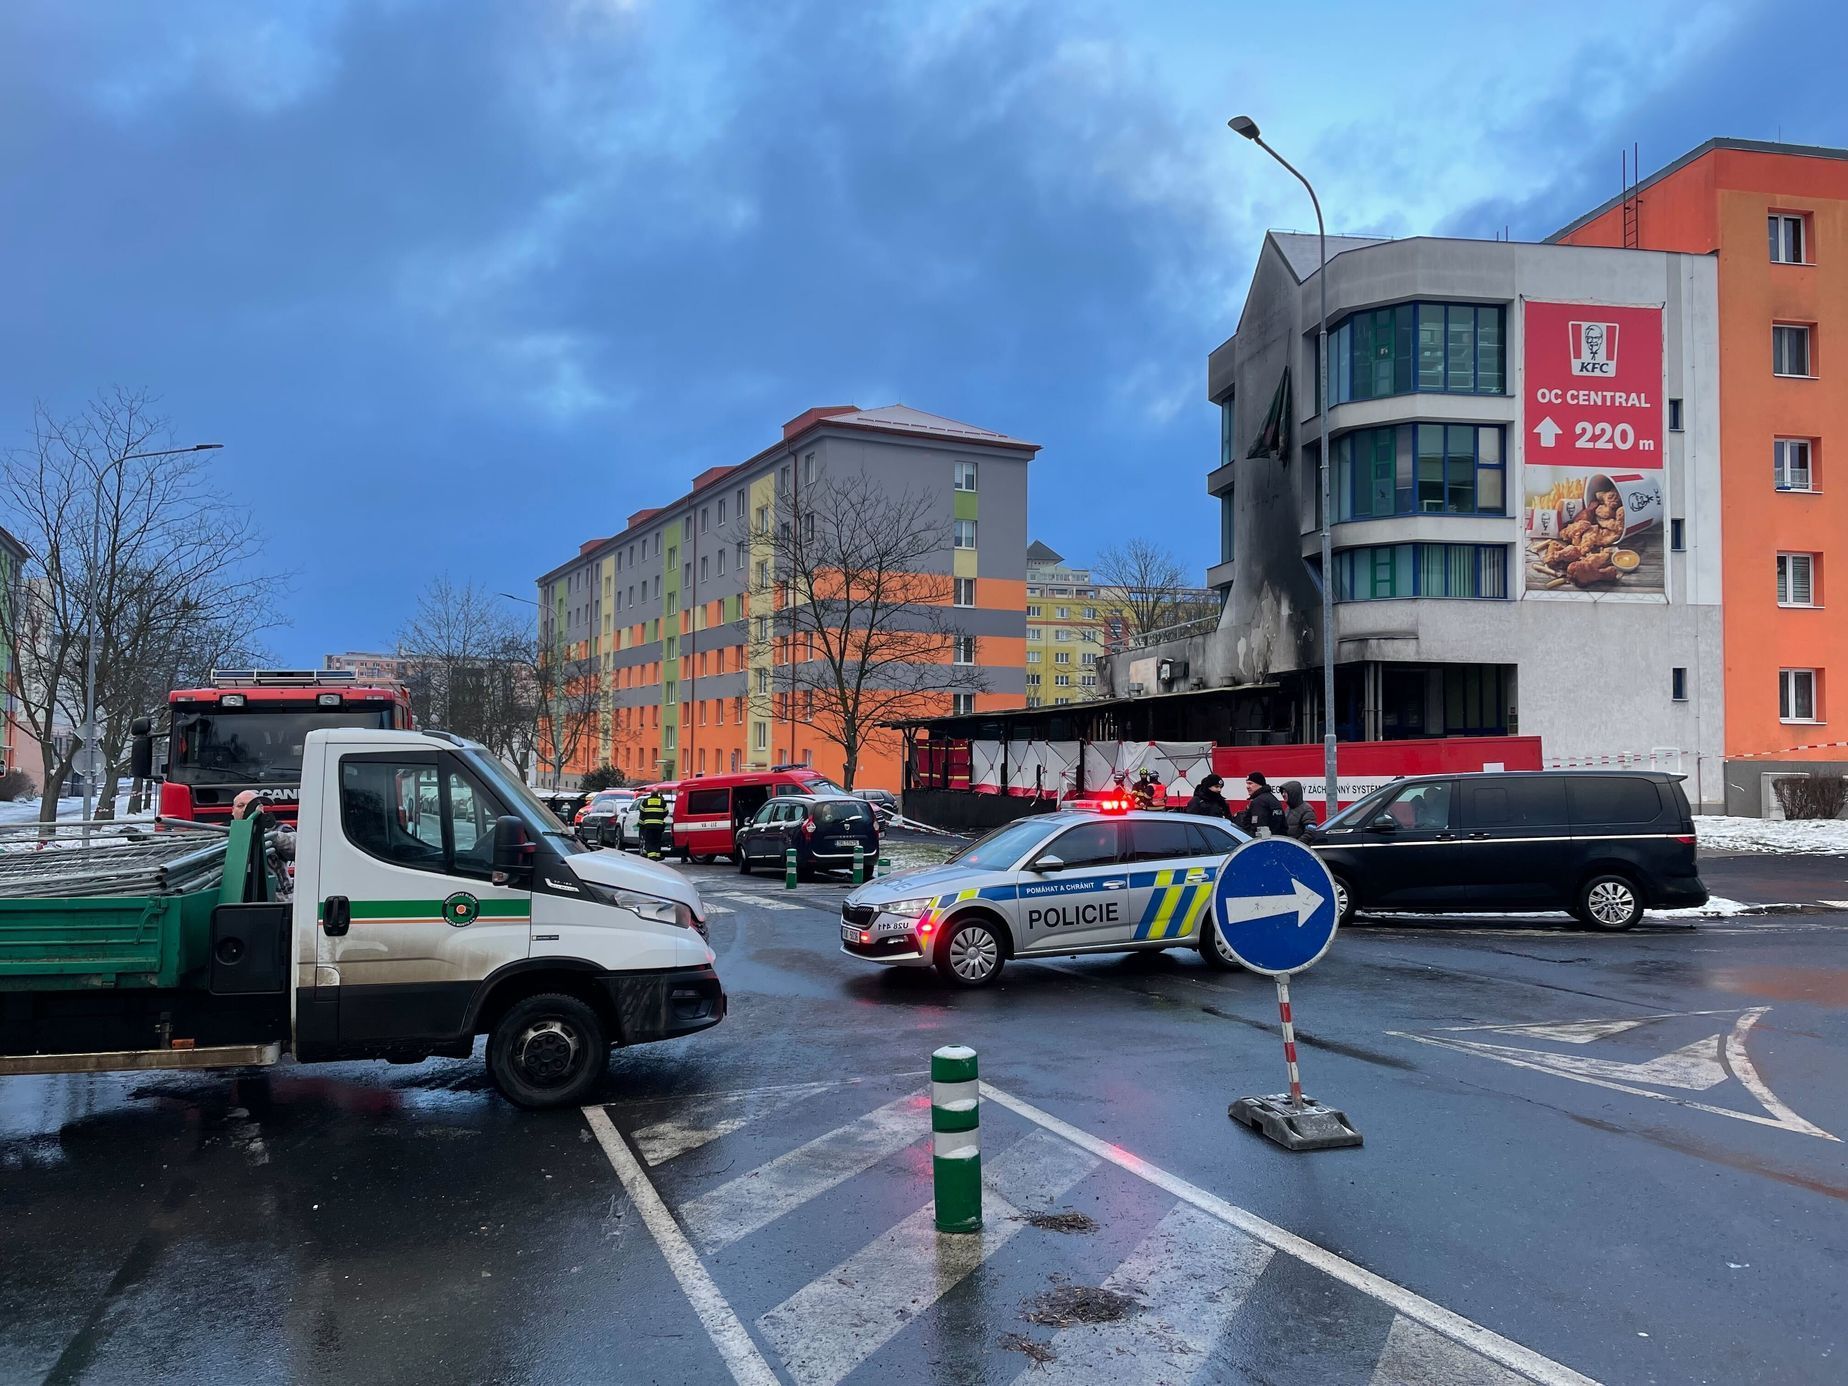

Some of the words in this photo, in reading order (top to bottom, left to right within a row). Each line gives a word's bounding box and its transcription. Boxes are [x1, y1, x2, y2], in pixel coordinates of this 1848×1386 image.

[1579, 362, 1609, 374] KFC
[1537, 388, 1562, 404] OC
[1566, 390, 1650, 408] CENTRAL
[1574, 421, 1635, 450] 220
[1639, 439, 1654, 450] m
[1308, 783, 1350, 794] ZÁCHNNÝ
[1026, 884, 1058, 894] POMÁHAT
[1066, 882, 1095, 892] CHRÁNIT
[1028, 902, 1119, 930] POLICIE
